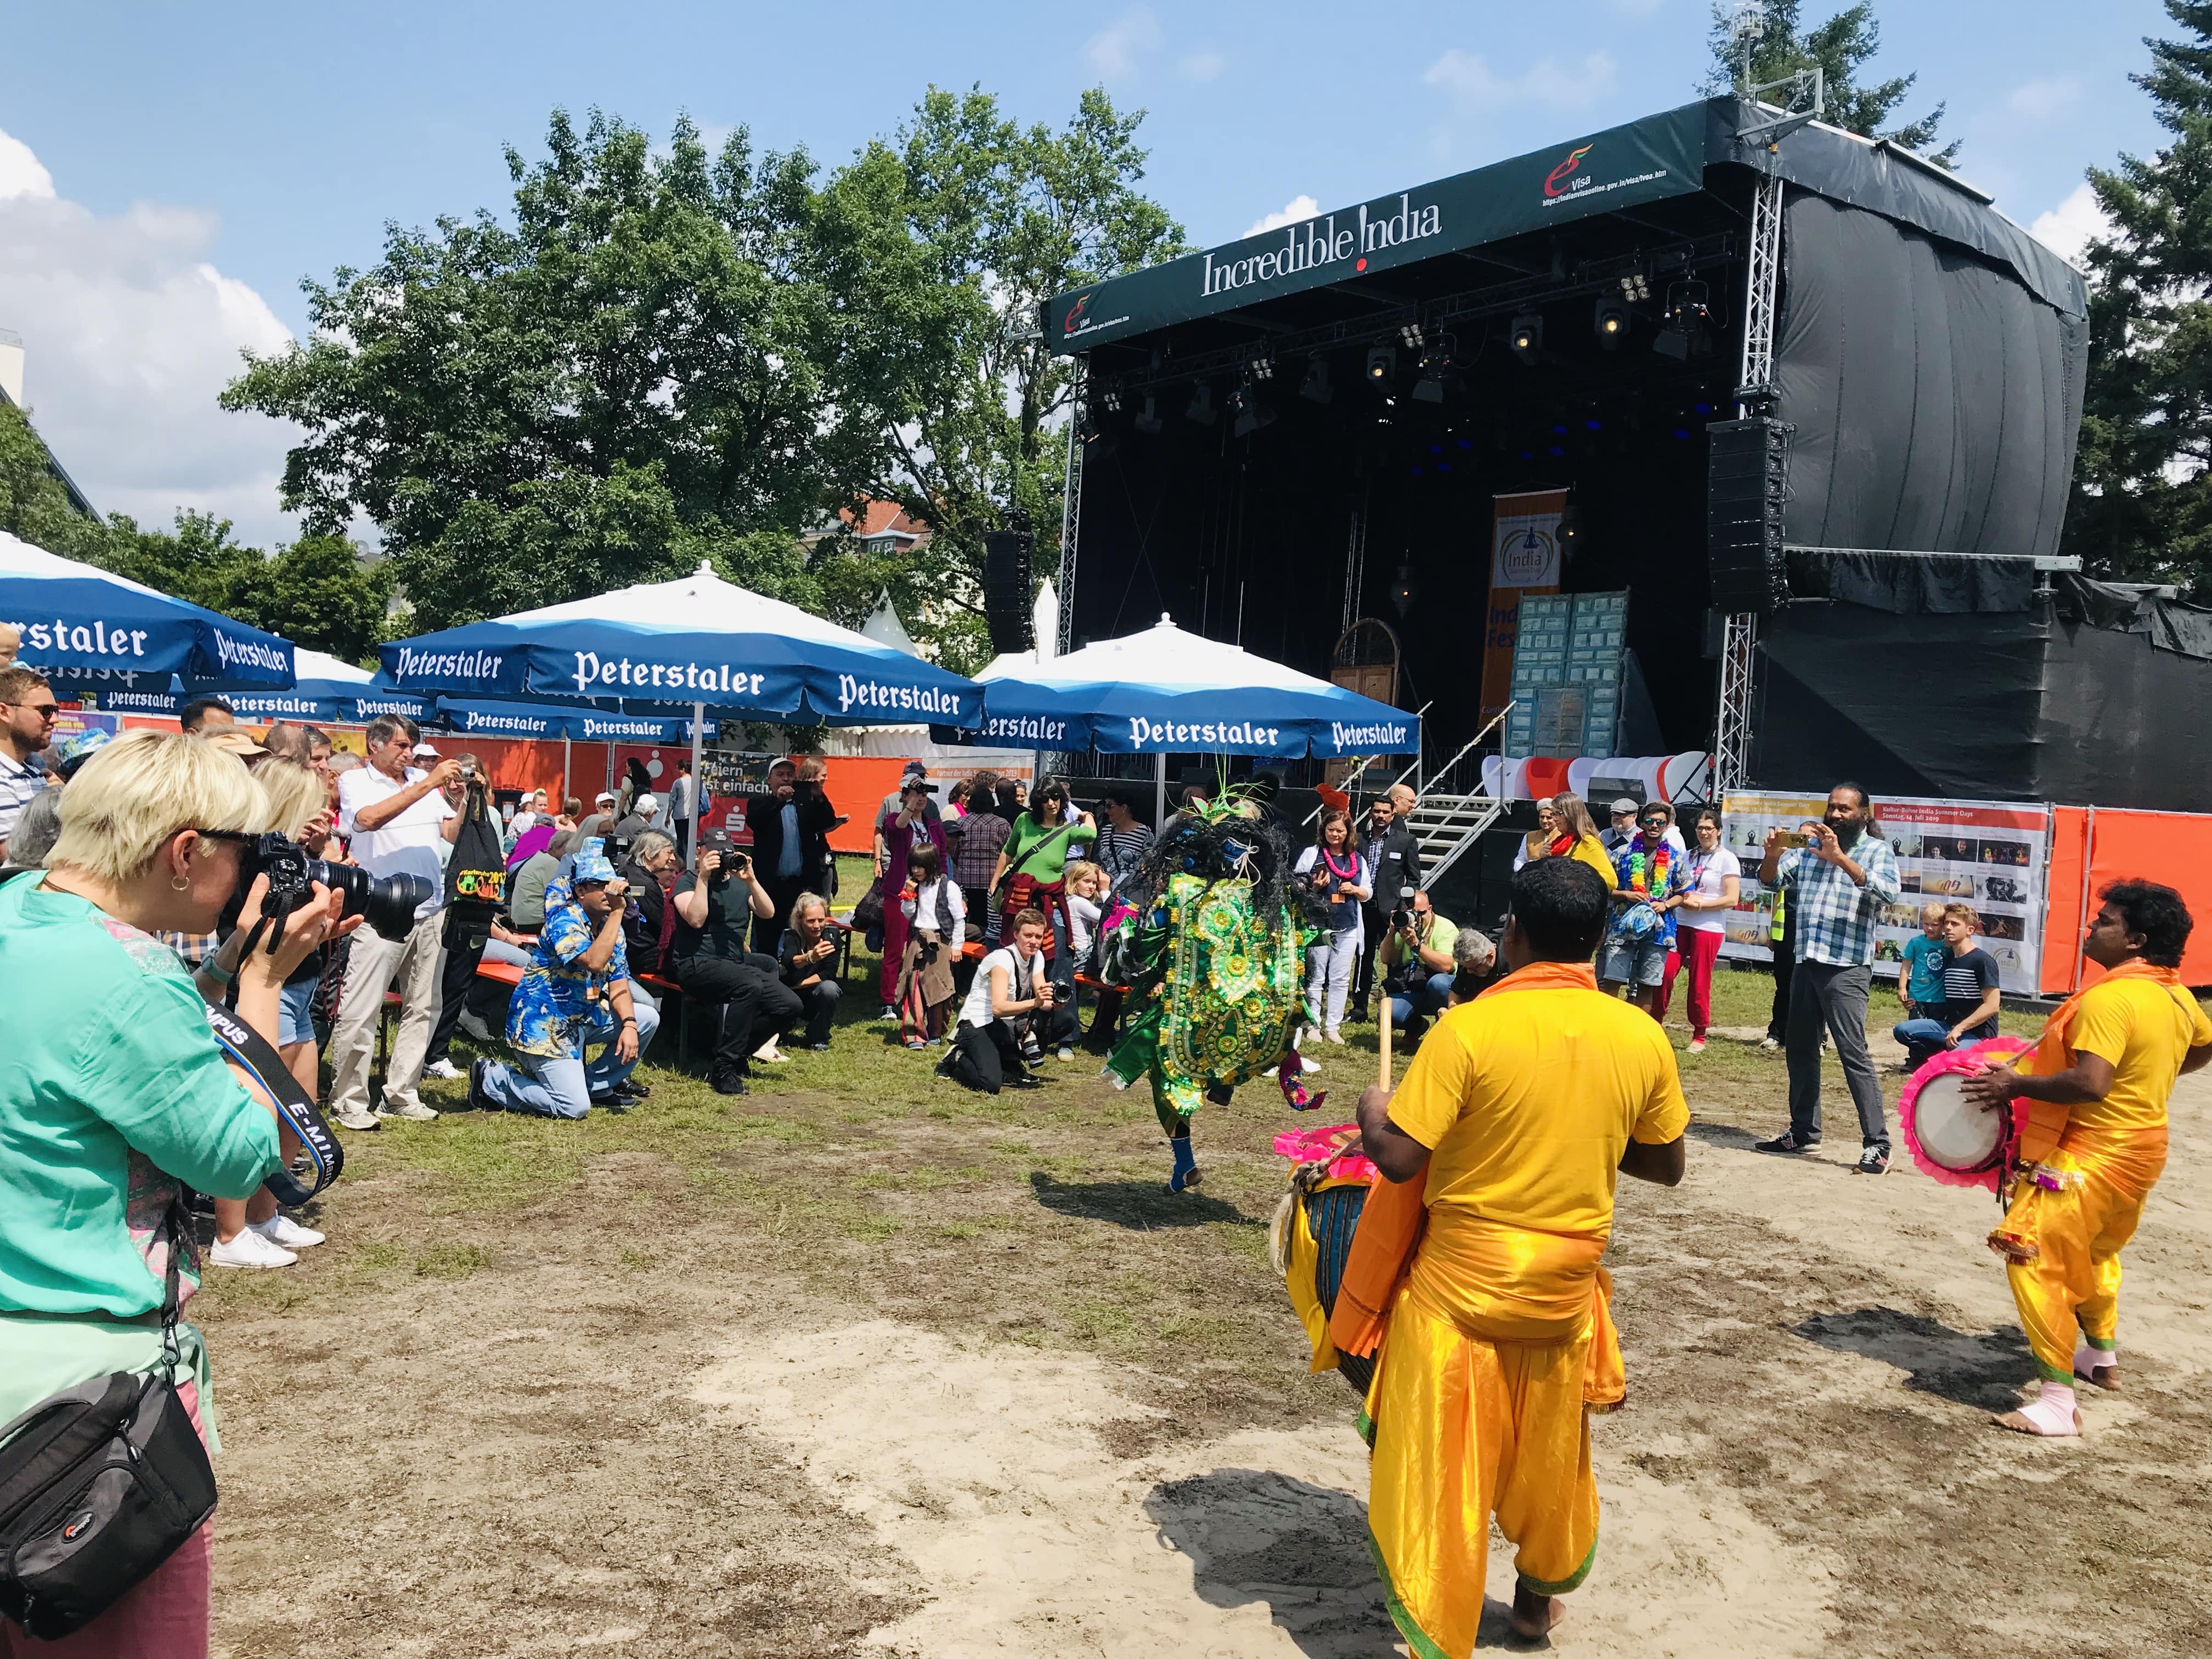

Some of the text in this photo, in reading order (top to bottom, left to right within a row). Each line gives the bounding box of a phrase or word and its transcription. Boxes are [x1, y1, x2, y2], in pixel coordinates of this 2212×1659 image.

[1572, 175, 1591, 191] Visa
[1200, 215, 1354, 297] Incredible
[1509, 551, 1541, 567] India
[9, 619, 148, 656] rstaler
[213, 627, 289, 673] Peterstaler
[395, 647, 503, 685] Peterstaler
[572, 651, 765, 696] Peterstaler
[107, 691, 176, 709] Peterstaler
[356, 698, 423, 718] Peterstaler
[838, 674, 960, 715] Peterstaler
[466, 711, 547, 732] Peterstaler
[583, 718, 663, 738] Peterstaler
[956, 715, 1066, 741] erstaler
[1129, 717, 1279, 748] Peterstaler
[1332, 721, 1407, 749] Peterstaler
[703, 762, 743, 776] Feiern
[723, 778, 773, 794] einfach.
[206, 1004, 249, 1045] MPUS
